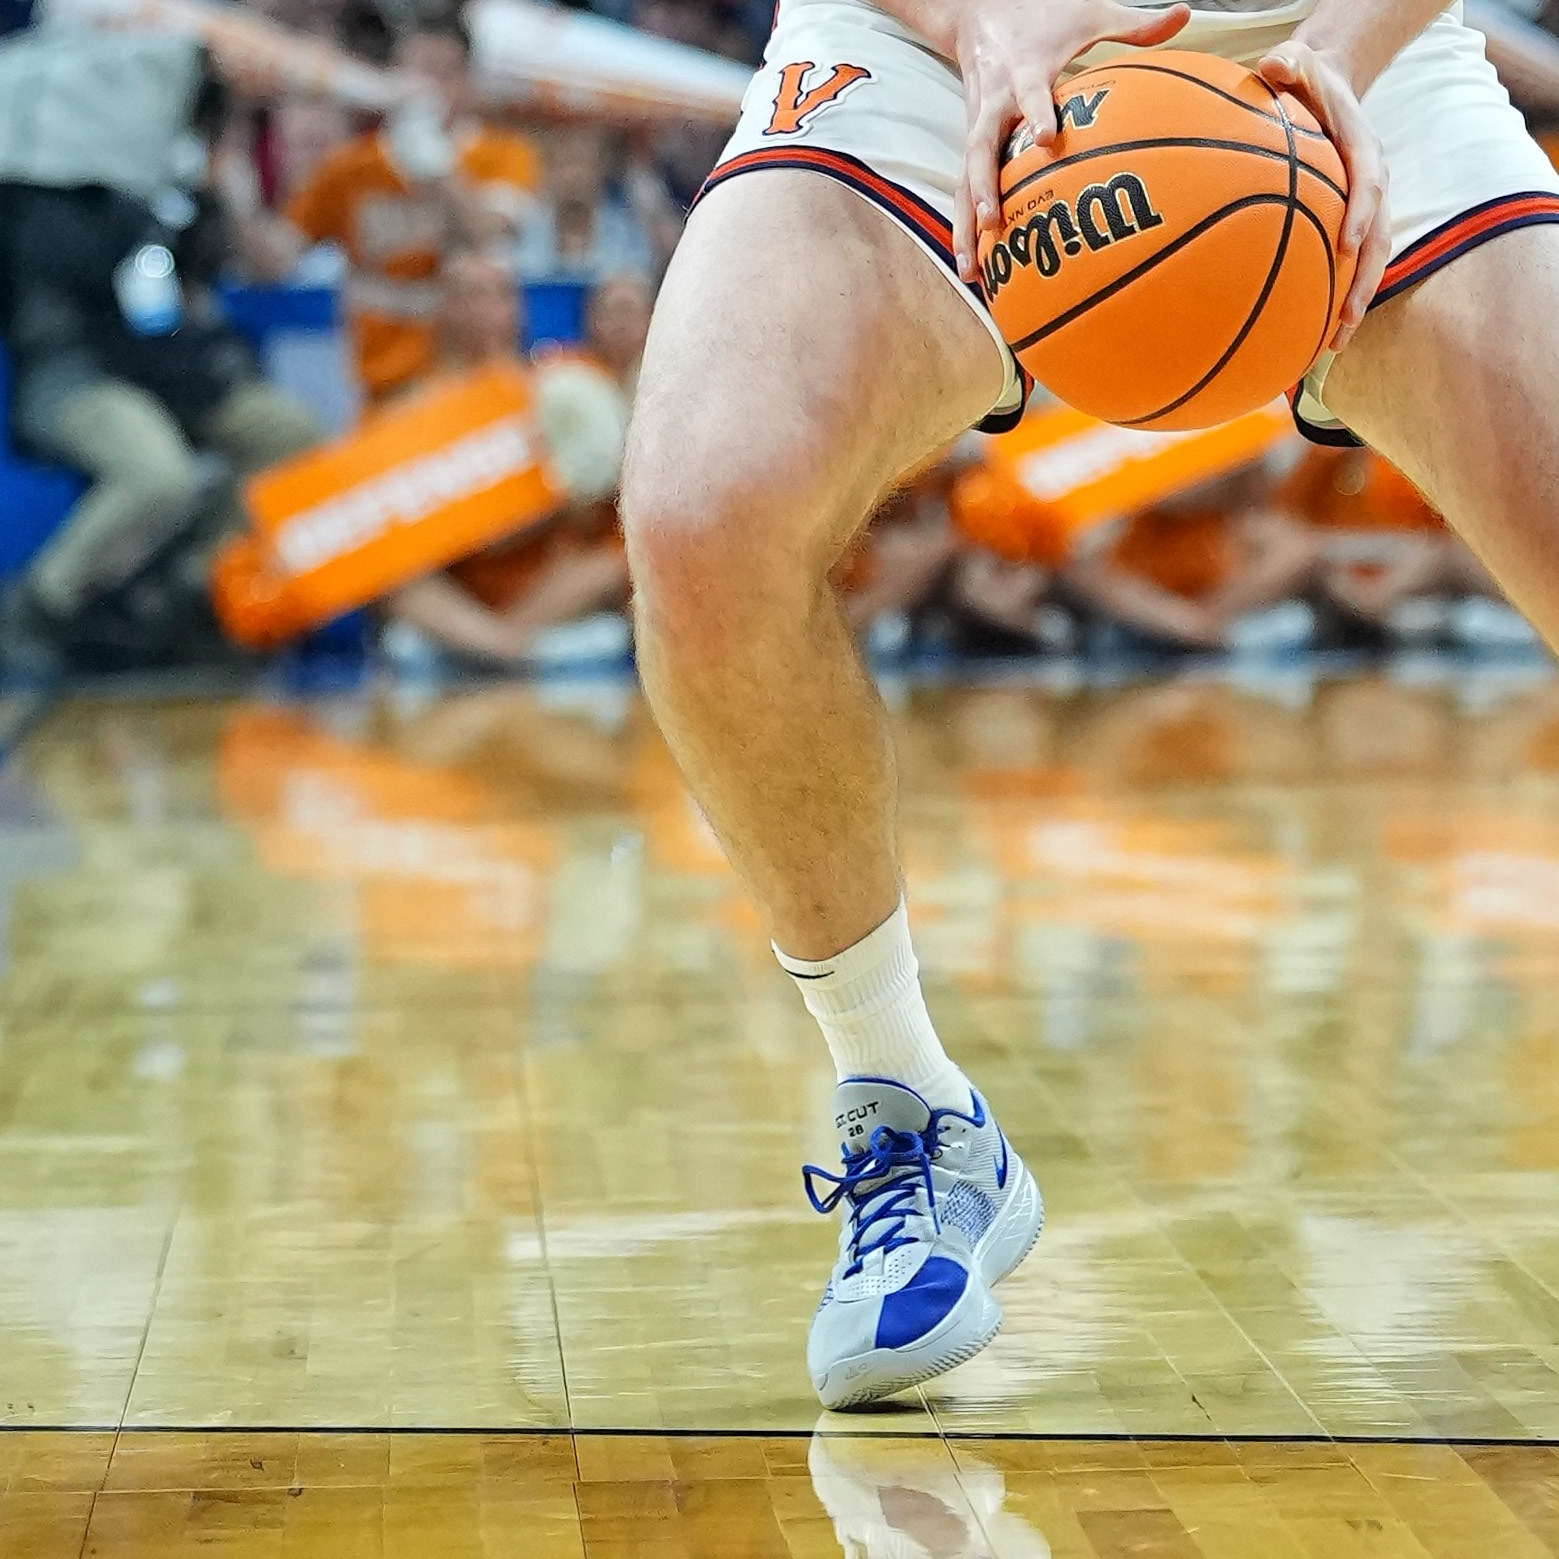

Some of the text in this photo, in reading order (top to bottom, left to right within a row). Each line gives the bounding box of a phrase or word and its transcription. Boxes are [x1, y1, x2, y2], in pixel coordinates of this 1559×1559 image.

[1027, 189, 1055, 210] EVO
[981, 172, 1165, 303] Wilson
[847, 1101, 879, 1122] CUT
